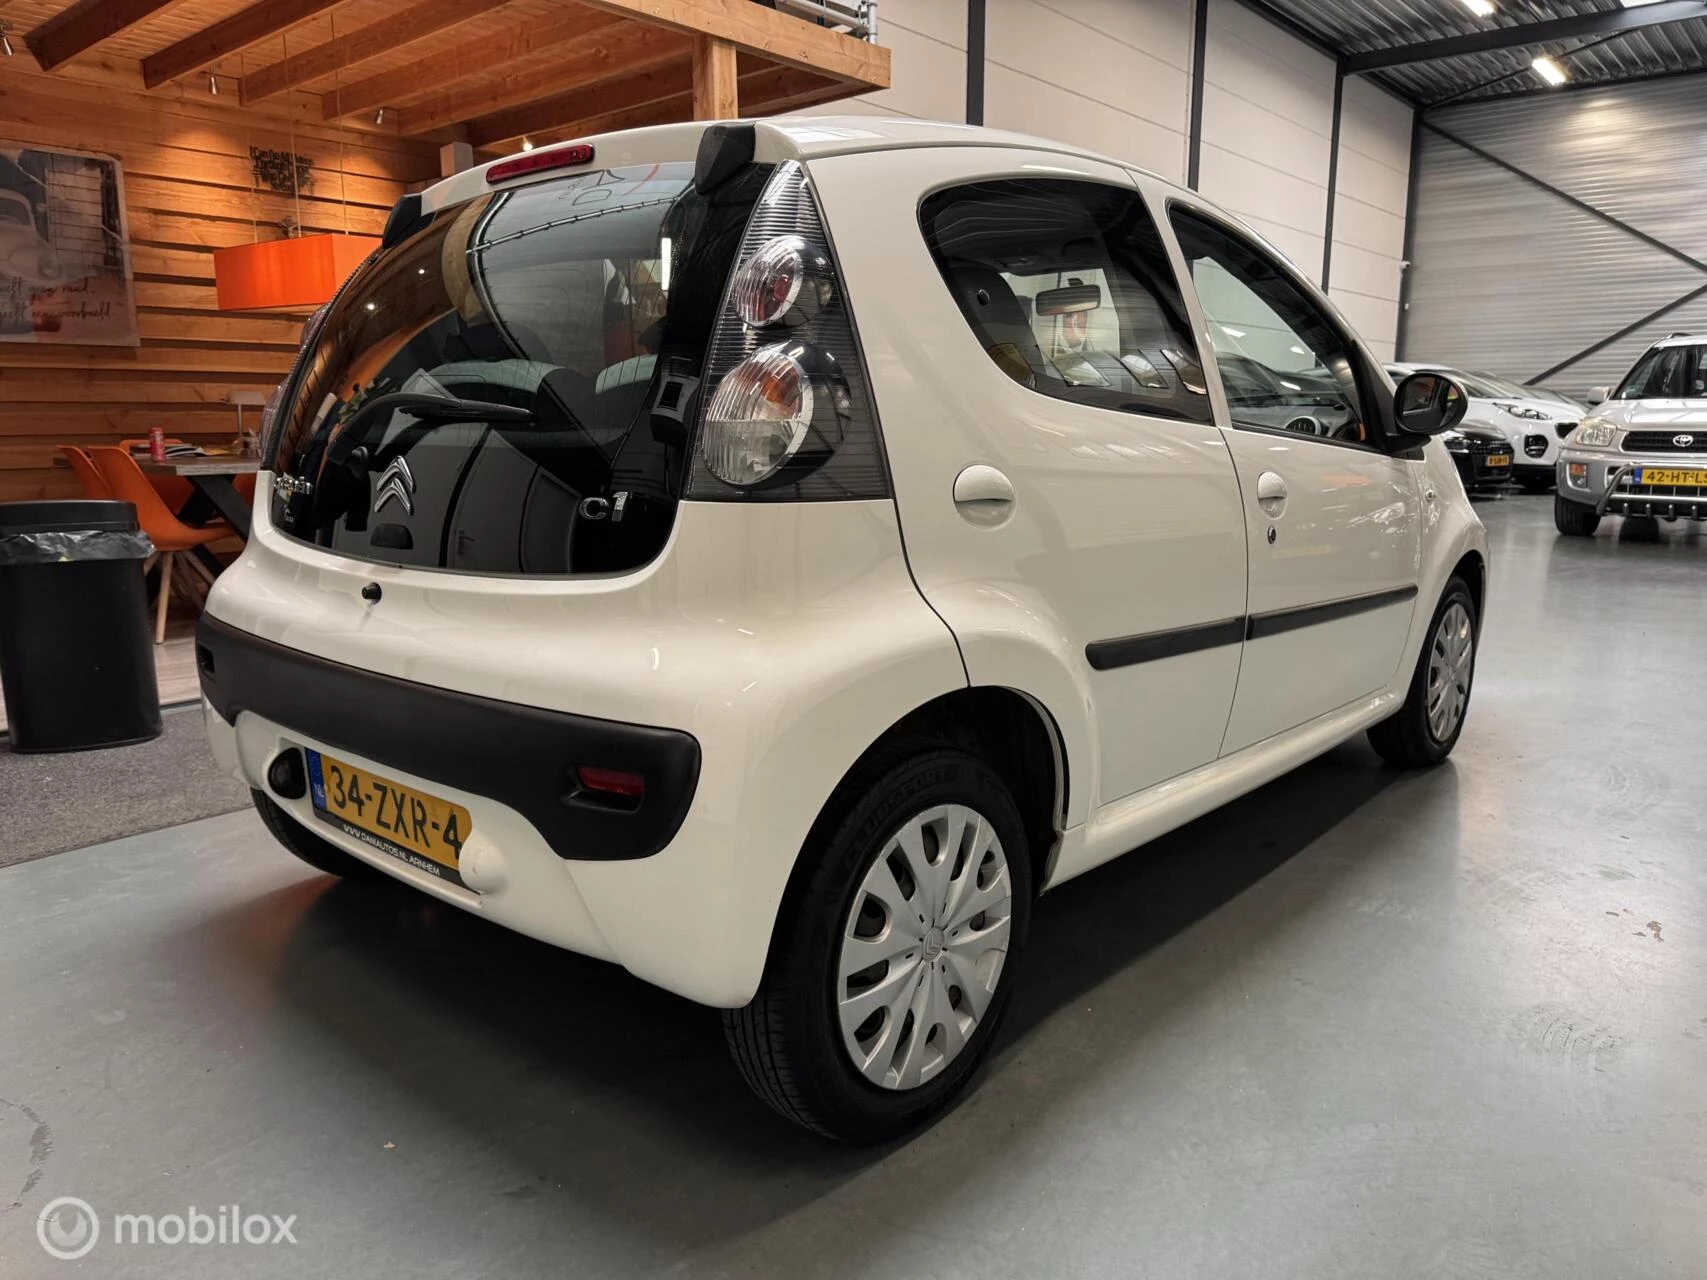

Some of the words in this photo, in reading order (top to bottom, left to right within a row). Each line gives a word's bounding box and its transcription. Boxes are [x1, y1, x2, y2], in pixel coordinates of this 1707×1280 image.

[579, 491, 628, 521] C1
[330, 765, 462, 861] 34-ZXR-4
[409, 855, 440, 876] ARNHEM
